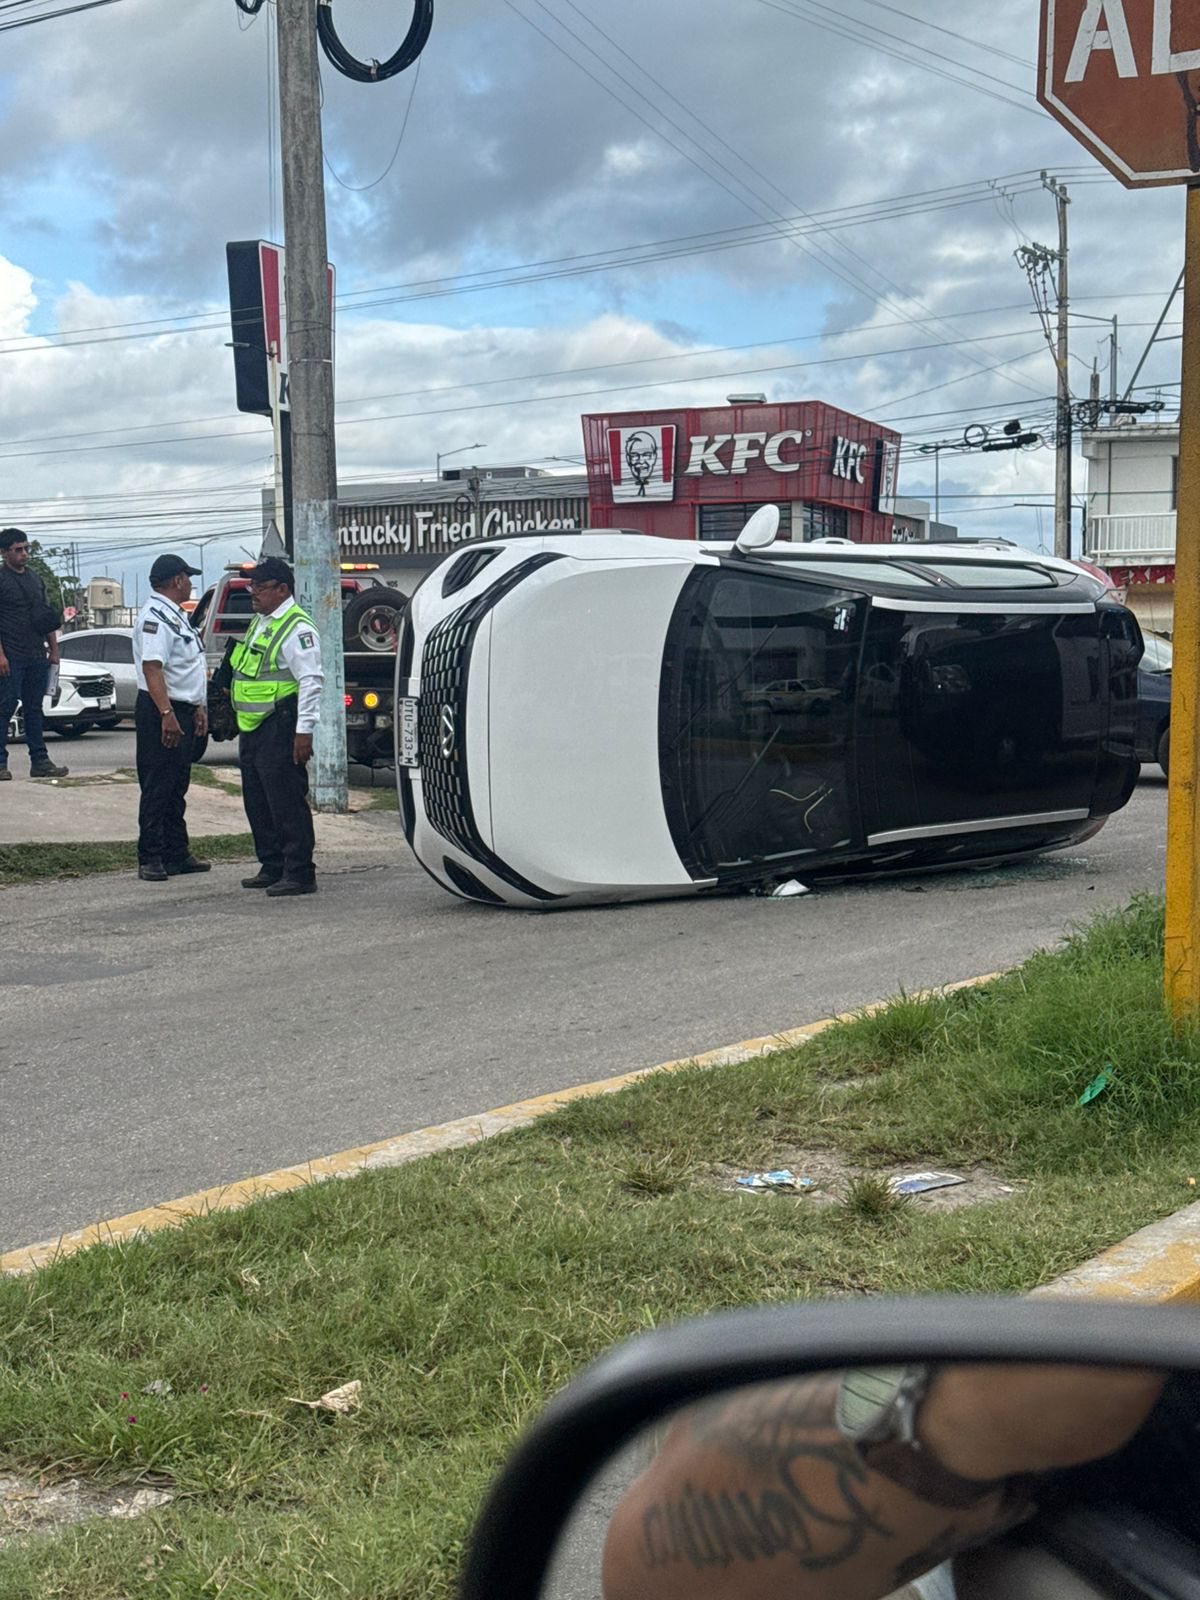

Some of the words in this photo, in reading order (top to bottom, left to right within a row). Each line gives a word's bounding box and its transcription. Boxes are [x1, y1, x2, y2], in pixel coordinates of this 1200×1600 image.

[684, 430, 803, 476] KFC
[832, 435, 867, 484] KFC
[414, 511, 477, 547] Fried
[482, 508, 576, 539] Chicken
